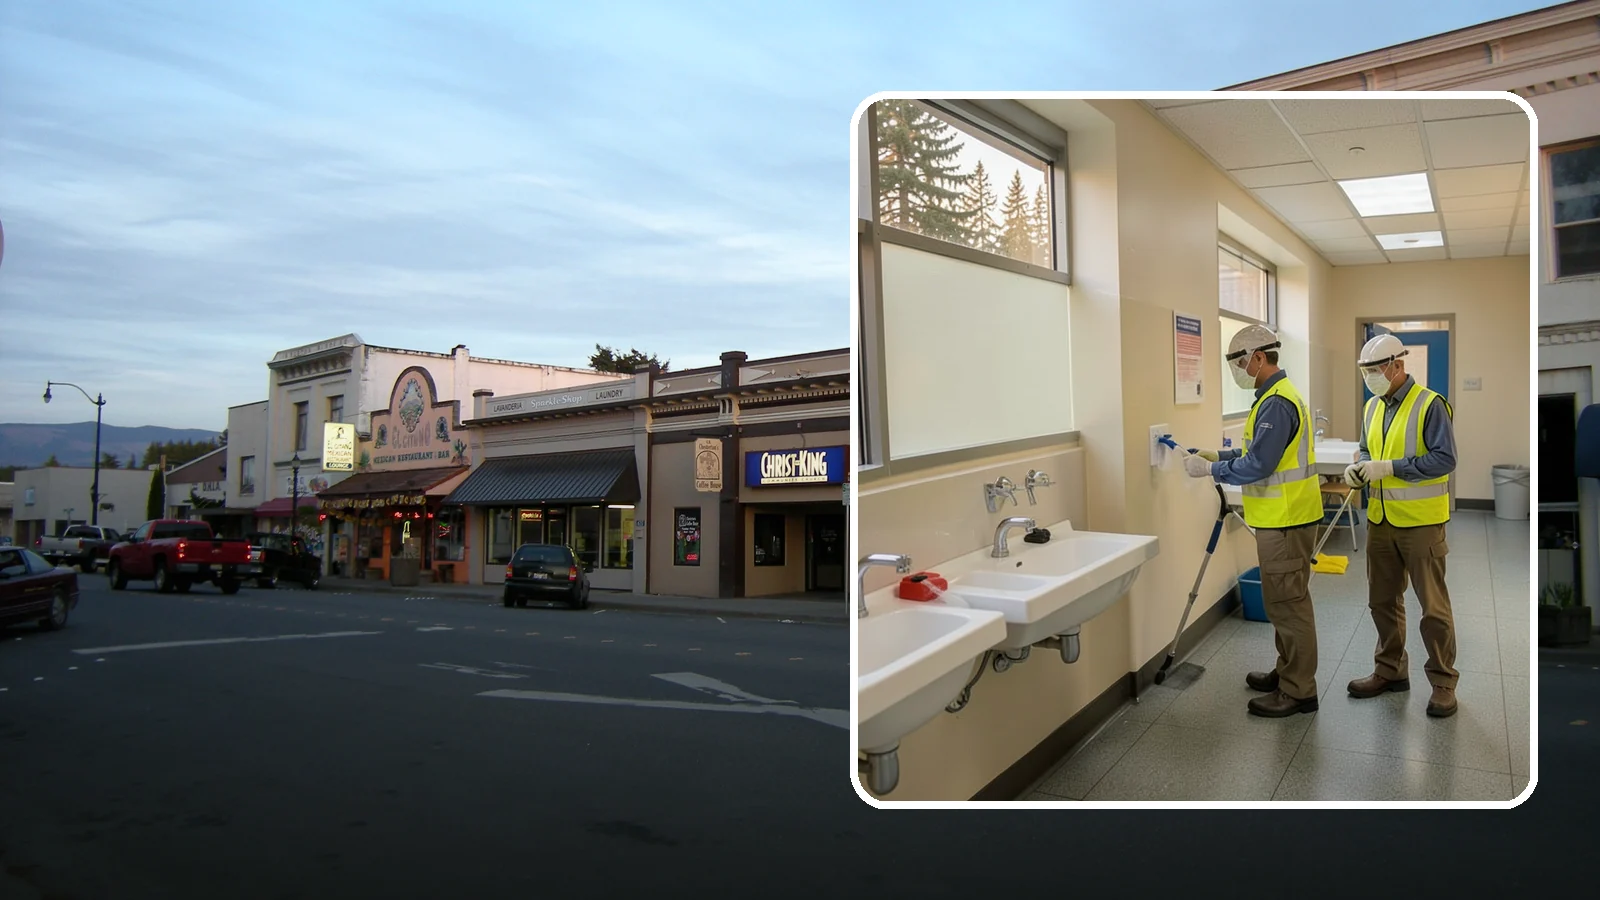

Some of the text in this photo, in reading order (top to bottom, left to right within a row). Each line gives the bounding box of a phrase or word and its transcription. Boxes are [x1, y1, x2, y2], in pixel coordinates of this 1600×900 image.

[595, 389, 624, 400] LAUNDRY
[493, 402, 522, 413] LAVANDERIA
[530, 394, 583, 409] Sparkle Shop
[373, 455, 396, 465] MEXICAN
[397, 451, 434, 463] RESTAURANT
[437, 449, 451, 459] BAR
[761, 450, 827, 477] CHRIST KING
[696, 480, 709, 489] Coffee
